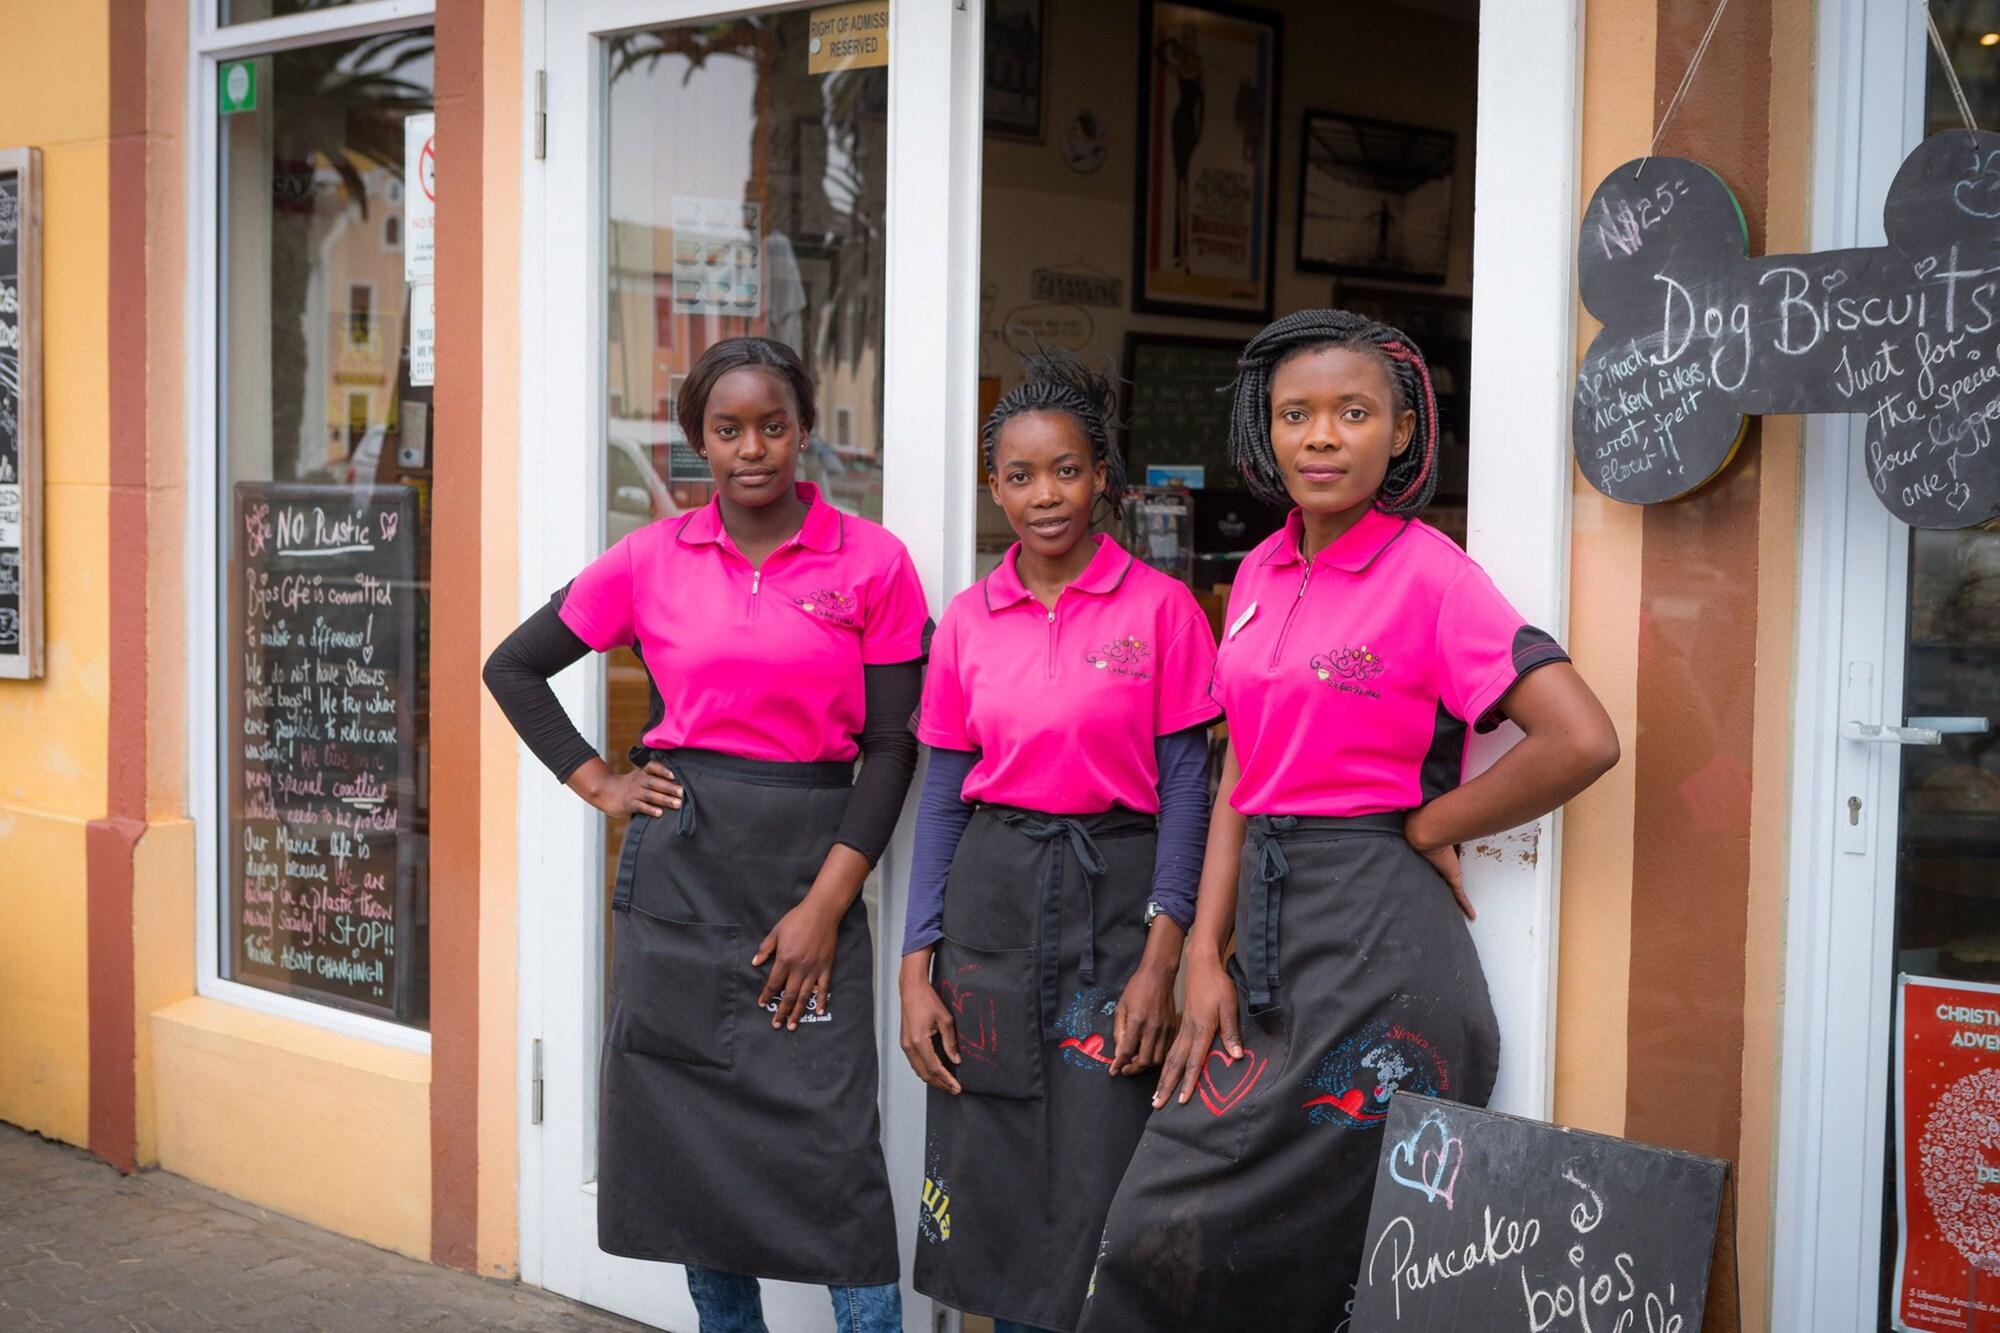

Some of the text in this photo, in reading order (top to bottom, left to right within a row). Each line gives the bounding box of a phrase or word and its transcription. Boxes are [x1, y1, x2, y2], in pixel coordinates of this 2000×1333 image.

[811, 18, 836, 37] RIGHT
[837, 16, 849, 33] OF
[830, 36, 878, 57] RESERVED
[1650, 244, 2000, 392] Dog Biscuits
[1834, 332, 1965, 400] Just for
[1869, 342, 2000, 440] the specia
[1871, 441, 1922, 494] four
[277, 505, 305, 549] NO
[245, 568, 280, 619] Bojos
[313, 575, 325, 604] is
[328, 572, 392, 606] committed
[297, 636, 306, 647] a
[245, 652, 263, 685] We
[316, 657, 339, 686] have
[319, 687, 338, 714] We
[244, 824, 269, 853] Our
[1369, 1205, 1541, 1320] Pancakes
